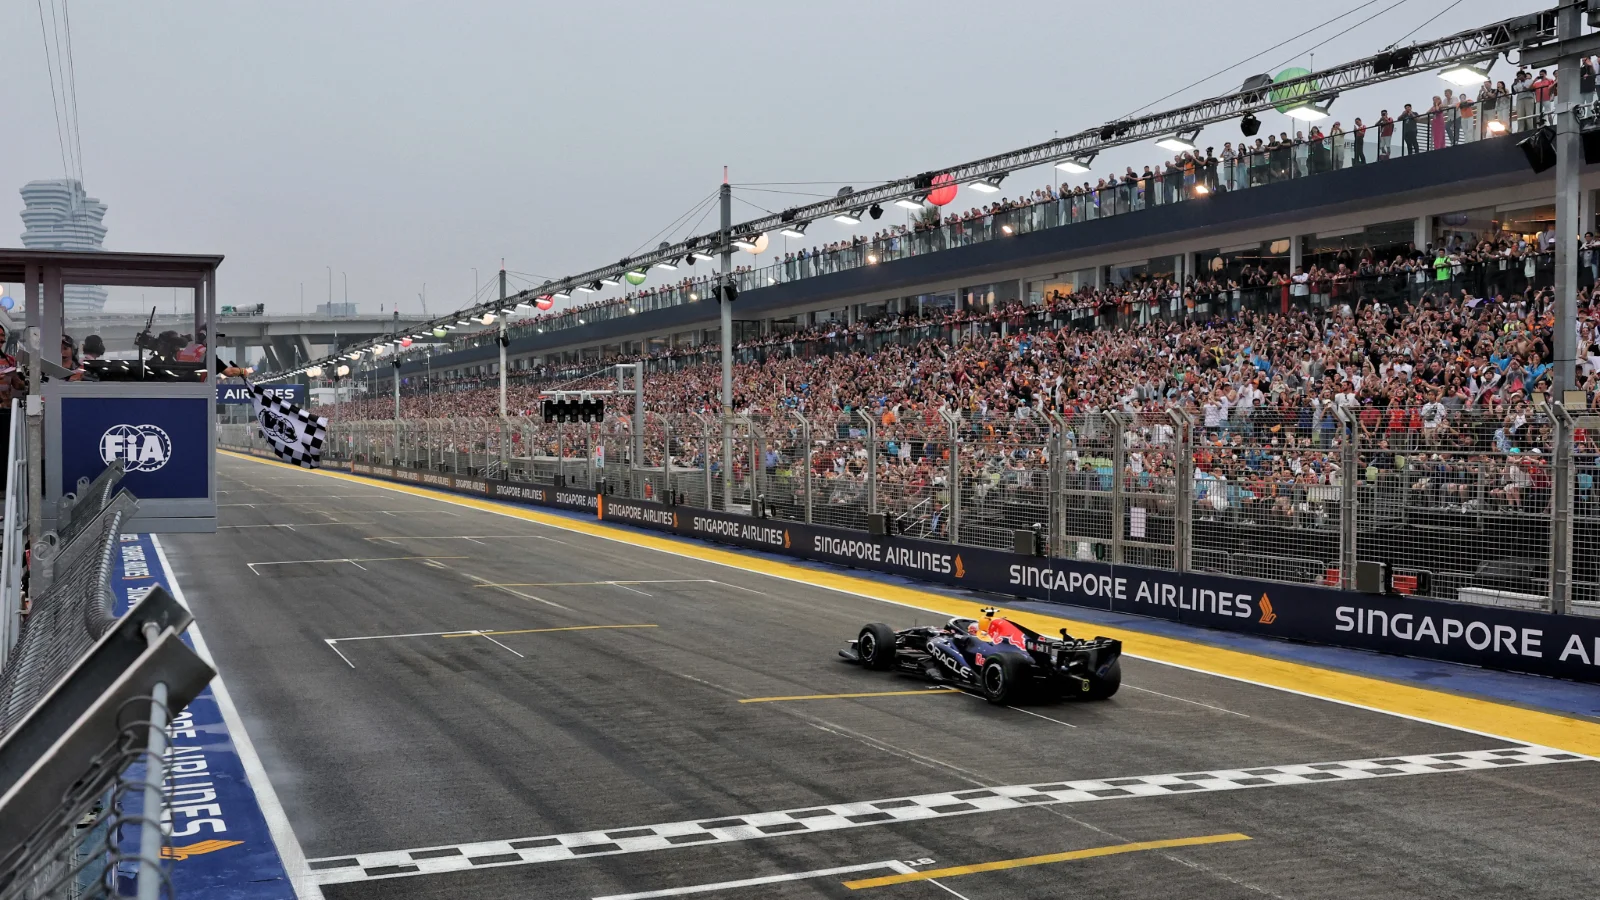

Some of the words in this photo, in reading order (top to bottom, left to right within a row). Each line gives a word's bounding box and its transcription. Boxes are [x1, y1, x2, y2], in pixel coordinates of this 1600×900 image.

[224, 389, 295, 399] AIRES
[455, 479, 472, 490] SINGAPORE
[472, 482, 486, 492] AIRLINES
[496, 485, 521, 497] SINGAPORE
[521, 488, 543, 501] AIRLINES
[556, 492, 586, 505] SINGAPORE
[587, 496, 598, 508] AIR
[608, 503, 642, 518] SINGAPORE
[642, 508, 673, 526] AIRLINES
[693, 516, 739, 537] SINGAPORE
[741, 524, 783, 545] AIRLINES
[814, 535, 881, 562] SINGAPORE
[885, 546, 951, 574] AIRLINES
[1009, 564, 1127, 600] SINGAPORE
[1135, 581, 1252, 618] AIRLINES
[1027, 641, 1045, 653] Mobil
[1335, 606, 1543, 658] SINGAPORE
[1558, 634, 1600, 667] AI
[926, 641, 972, 679] ORACLE
[160, 746, 227, 837] AIRLINES
